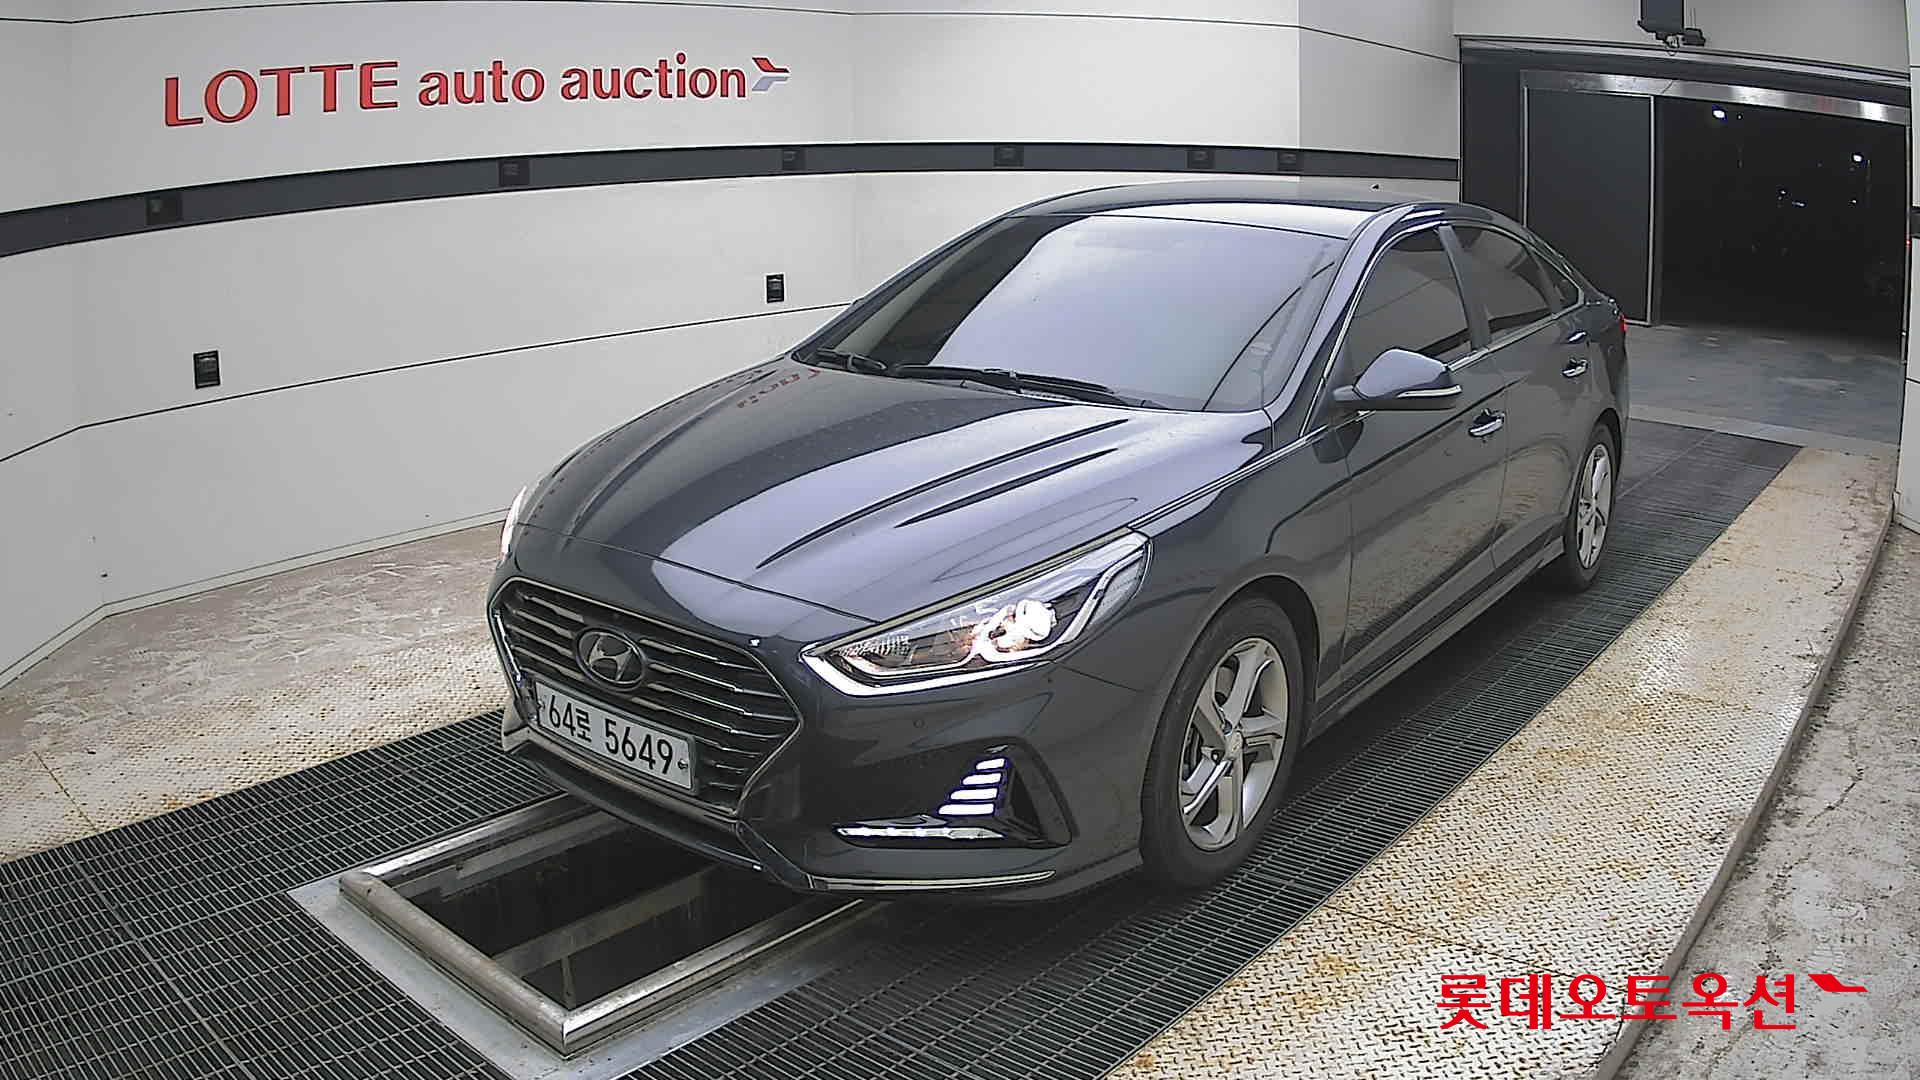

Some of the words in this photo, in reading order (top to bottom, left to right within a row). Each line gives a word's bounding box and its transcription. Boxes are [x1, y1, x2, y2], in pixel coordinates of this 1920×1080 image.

[164, 60, 400, 127] LOTTE
[418, 60, 545, 106] auto
[561, 52, 746, 101] auction
[549, 695, 592, 743] 64로
[604, 718, 674, 775] 5649
